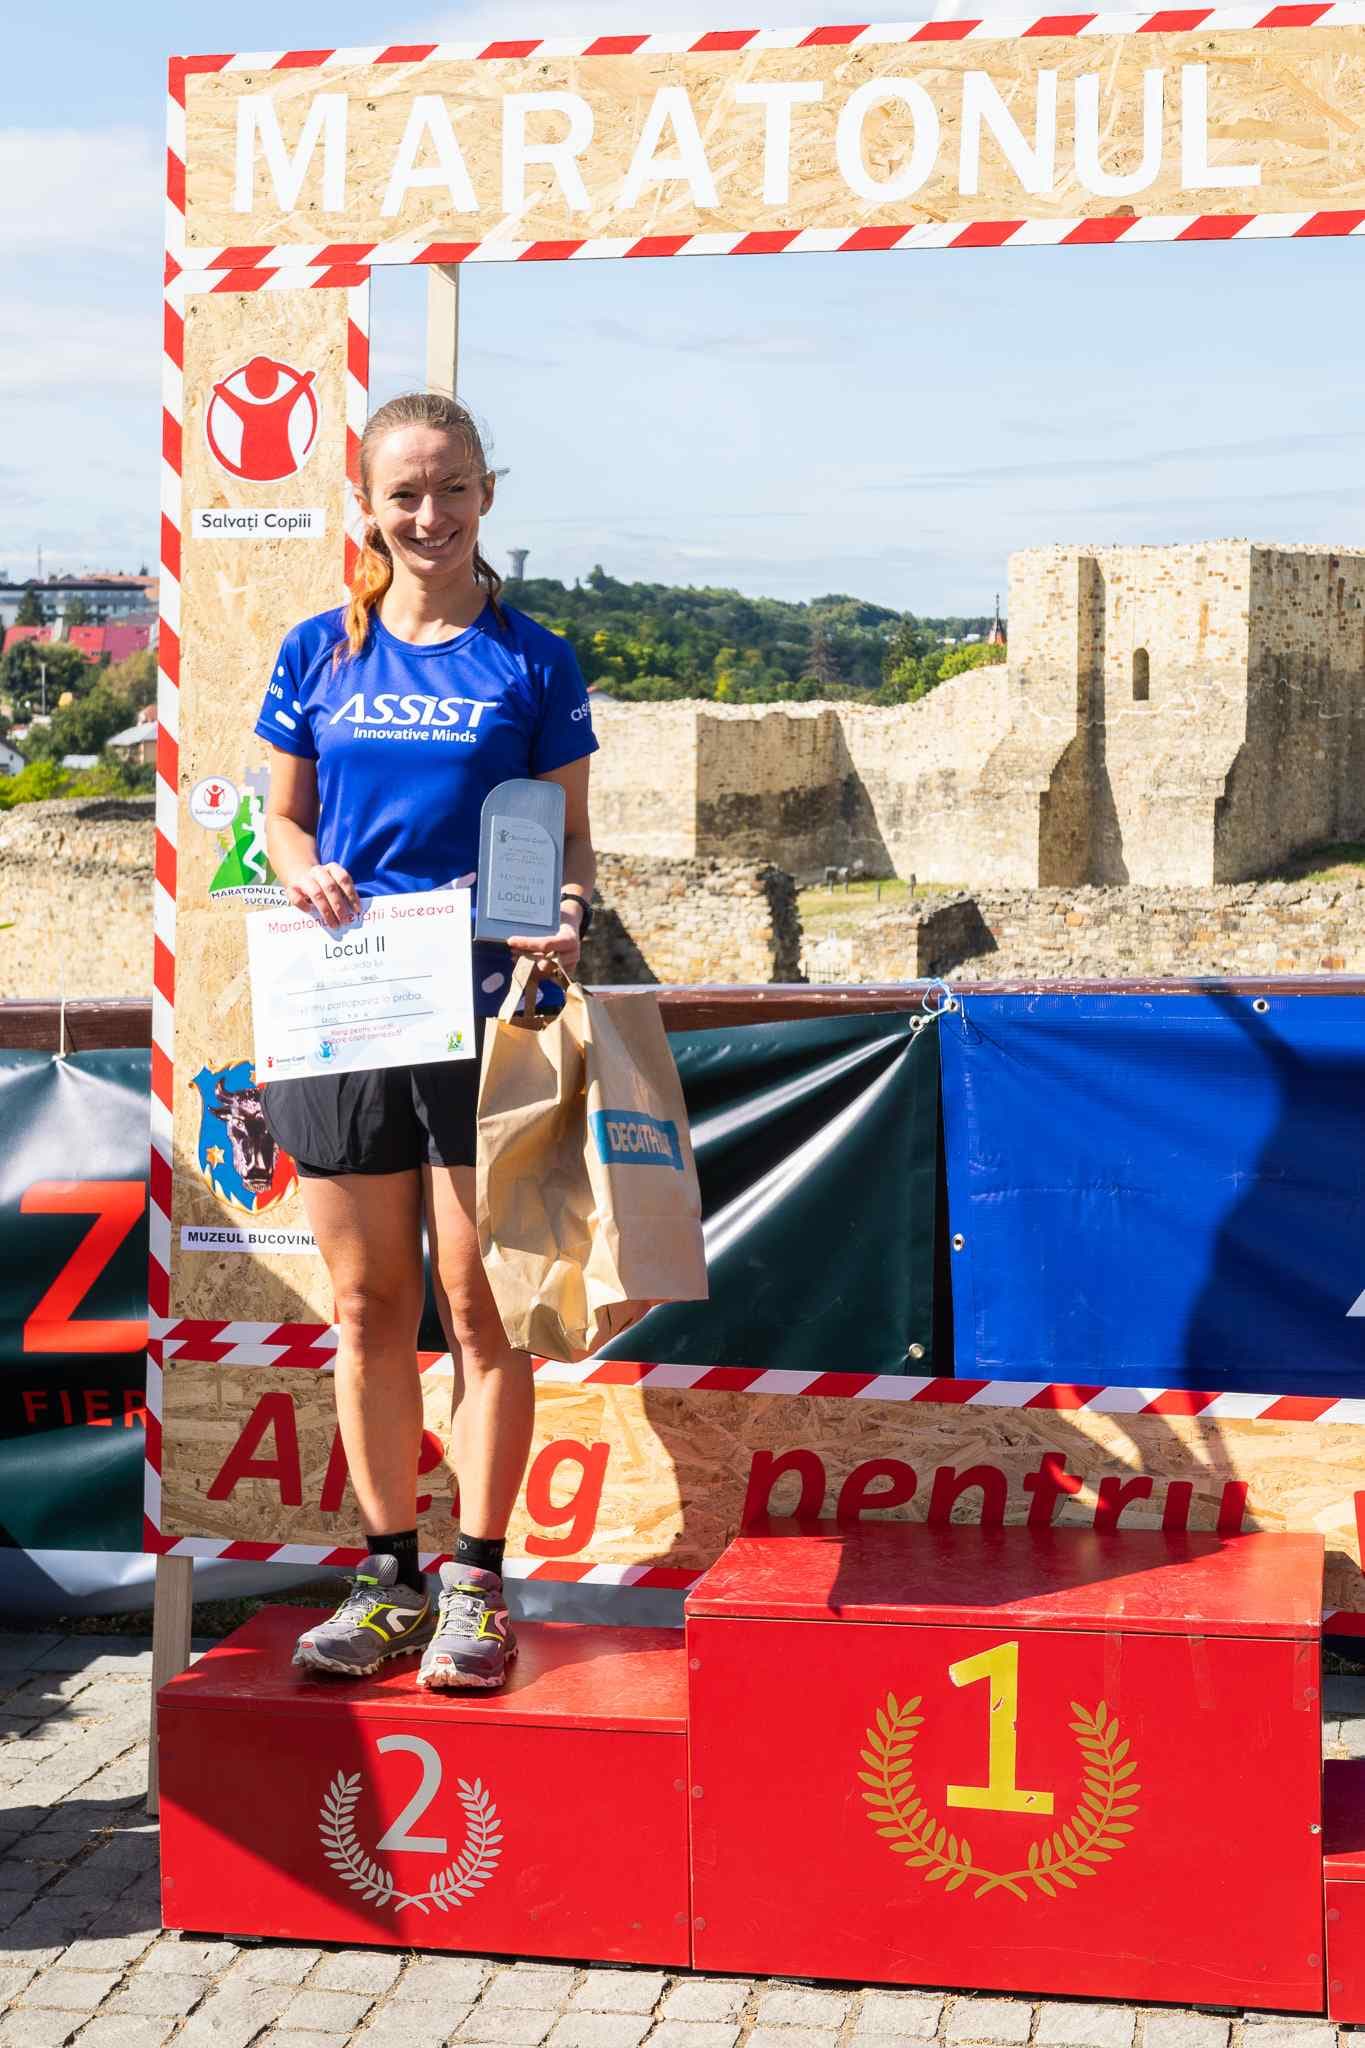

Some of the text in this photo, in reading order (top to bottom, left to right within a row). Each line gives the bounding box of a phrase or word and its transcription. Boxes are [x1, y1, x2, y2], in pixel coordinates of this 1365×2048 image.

[232, 64, 1262, 217] MARATONUL
[264, 513, 312, 532] Copiii
[329, 692, 498, 728] ASSIST
[353, 727, 477, 743] Innovative Minds
[211, 887, 276, 899] MARATONUL
[497, 891, 536, 905] LOCUL
[267, 917, 329, 934] Maratonu
[390, 903, 455, 919] Suceava
[325, 935, 386, 960] Locul II
[187, 1231, 244, 1244] MUZEUL
[946, 1640, 1054, 1816] 1
[375, 1734, 448, 1854] 2
